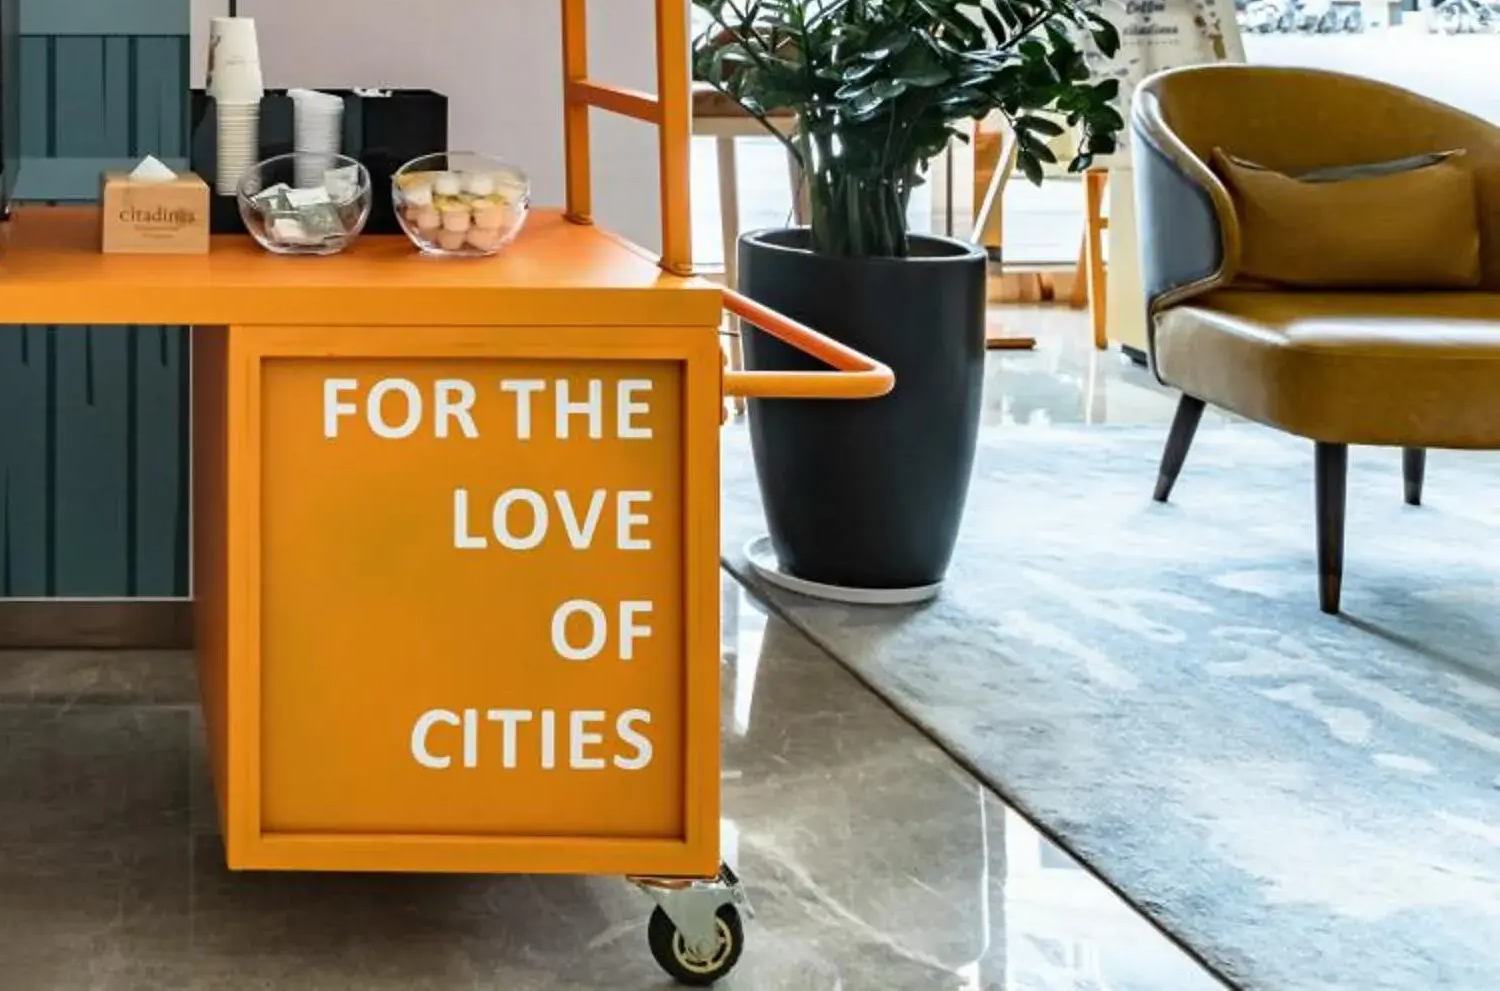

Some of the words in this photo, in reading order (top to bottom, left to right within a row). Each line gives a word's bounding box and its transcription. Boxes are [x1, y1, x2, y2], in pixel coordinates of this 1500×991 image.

[323, 377, 479, 439] FOR
[499, 378, 654, 440] THE
[453, 488, 653, 550] LOVE
[550, 599, 654, 661] OF
[410, 708, 654, 770] CITIES
